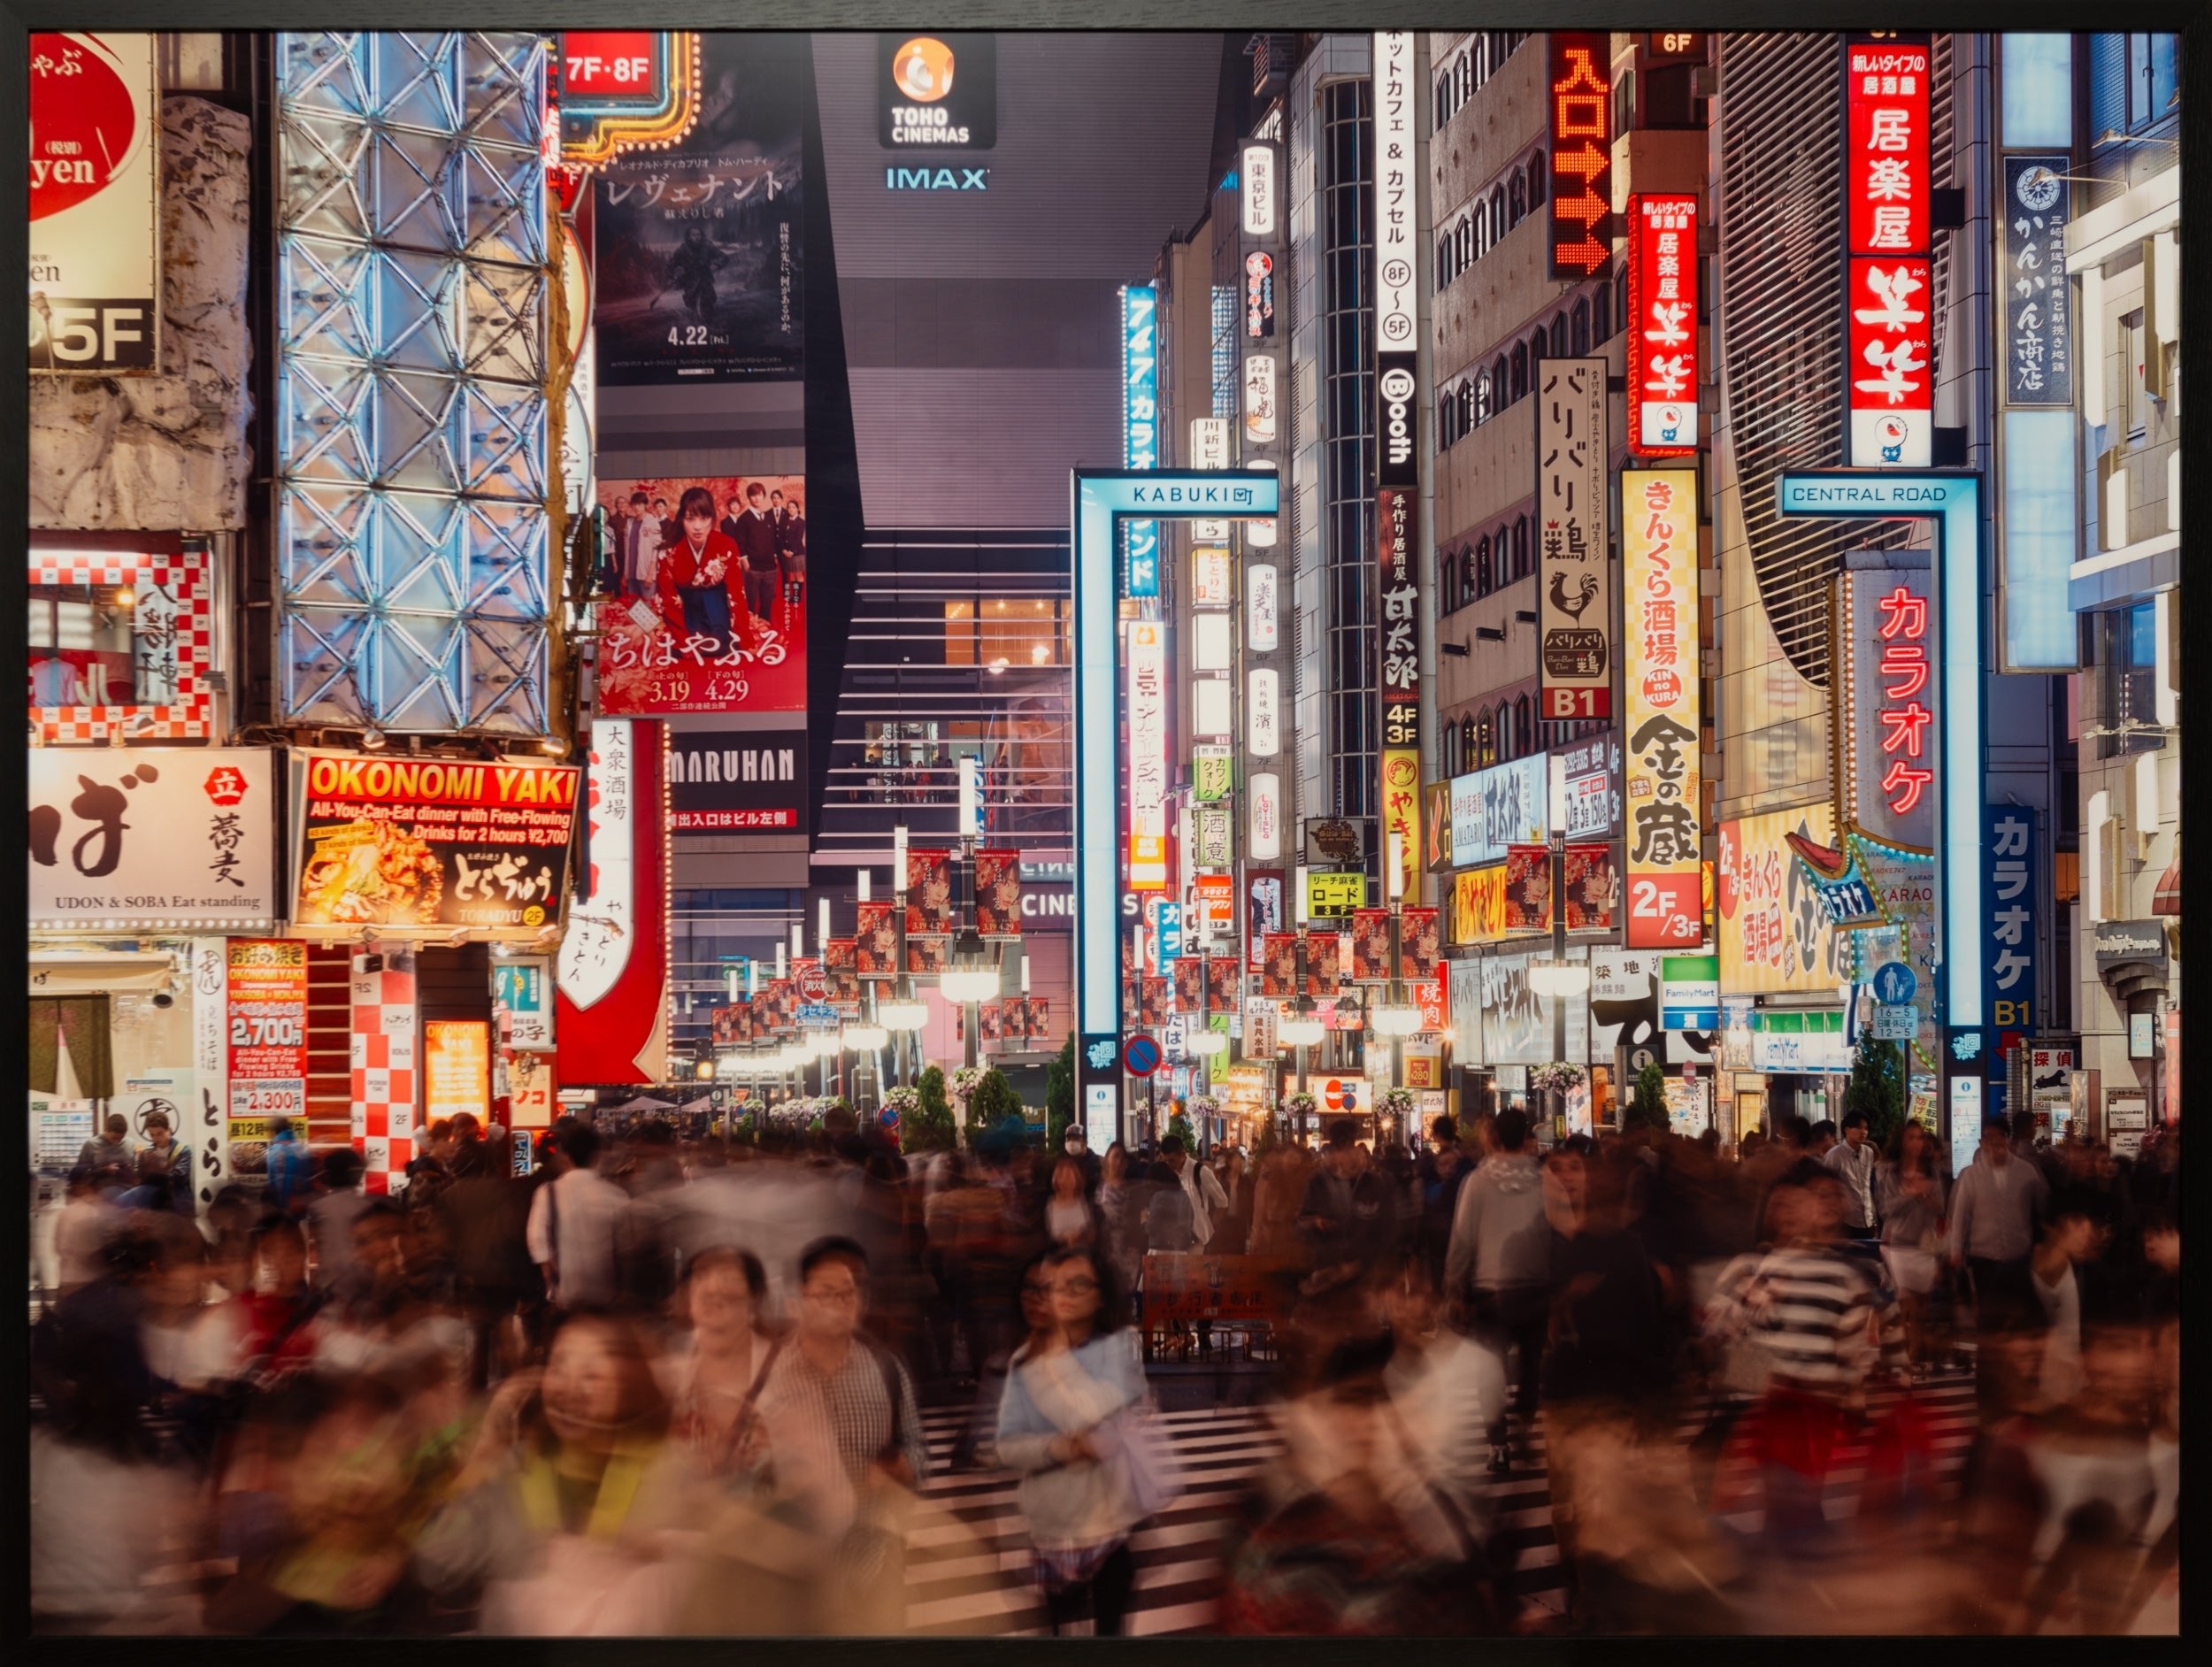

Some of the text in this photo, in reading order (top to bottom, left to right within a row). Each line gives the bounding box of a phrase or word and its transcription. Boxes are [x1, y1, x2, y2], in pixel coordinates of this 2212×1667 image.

[1663, 34, 1692, 52] 6F
[1852, 54, 1926, 73] 新しいタイプの
[1555, 49, 1609, 139] 入口
[1863, 76, 1917, 96] 居酒屋
[891, 106, 949, 127] TOHO
[891, 127, 970, 143] CINEMAS
[1387, 143, 1403, 160] &
[30, 157, 96, 189] yen
[887, 167, 987, 190] IMAX
[1867, 108, 1913, 249] 居楽屋
[607, 170, 783, 210] レヴェナント
[1250, 164, 1267, 227] 東京ビル
[1386, 169, 1405, 245] カプセル
[1641, 202, 1696, 216] 新しいタイプの
[1388, 267, 1406, 281] 8F
[1655, 232, 1680, 300] 居楽屋
[2014, 216, 2047, 391] かんかん商店
[52, 307, 143, 362] 5F
[667, 325, 708, 346] 4.22
[1388, 320, 1406, 334] 5F
[1380, 368, 1416, 465] Booth
[1793, 487, 1947, 502] CENTRAL ROAD
[1391, 494, 1408, 581] 手作り居酒屋
[1130, 520, 1156, 587] ンド
[1643, 480, 1678, 666] きんくら酒場
[606, 630, 787, 670] ちはやふる
[1382, 584, 1419, 690] 甘太郎
[1546, 633, 1603, 649] バリバリ
[1646, 670, 1673, 683] KIN
[1653, 681, 1671, 691] no
[649, 680, 749, 703] 3.19 4.29
[1554, 688, 1594, 717] B1
[1645, 690, 1680, 703] KURA
[1878, 587, 1933, 816] カラオケ
[1386, 704, 1417, 724] 4F
[1386, 725, 1417, 744] 3F
[605, 726, 627, 820] 大衆酒場
[668, 749, 795, 783] MARUHAN
[211, 771, 242, 800] 立
[311, 758, 577, 804] OKONOMI YAKI
[1629, 712, 1699, 866] 金の蔵
[311, 801, 571, 829] All-You-Can-Eat dinner with Free-Flowing
[1443, 788, 1452, 863] 入口
[413, 825, 456, 841] Drinks
[457, 826, 476, 841] for
[478, 827, 487, 841] 2
[489, 828, 526, 843] hours
[208, 811, 246, 887] 蕎麦
[1313, 876, 1358, 886] リーチ麻雀
[1742, 849, 1782, 903] きんくら
[55, 895, 261, 910] UDON & SOBA Eat standing
[1312, 887, 1359, 903] ロード
[1632, 880, 1677, 918] 2F
[1820, 882, 1869, 926] カラオケ
[1993, 816, 2032, 990] カラオケ
[457, 909, 542, 924] TORADYU 2F
[1420, 984, 1442, 1026] 焼肉
[1665, 988, 1716, 1000] FamilyMart
[1993, 999, 2032, 1027] B1
[511, 1026, 546, 1041] の子
[2034, 1050, 2072, 1067] 探偵
